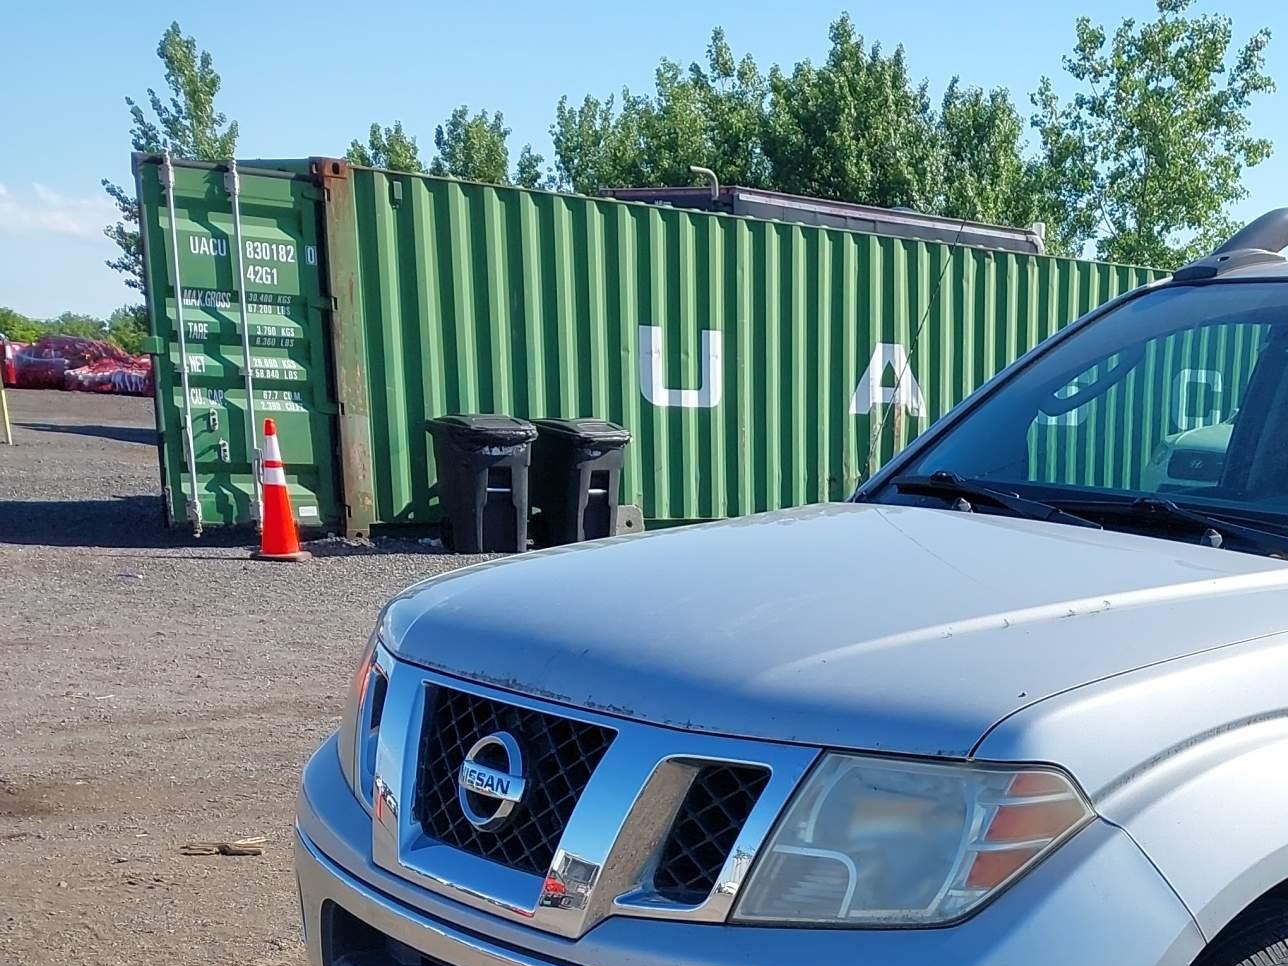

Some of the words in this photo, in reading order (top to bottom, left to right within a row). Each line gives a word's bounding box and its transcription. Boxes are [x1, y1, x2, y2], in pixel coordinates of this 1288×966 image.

[189, 235, 227, 256] UACU
[246, 240, 295, 262] 830182
[247, 265, 278, 285] 42G1
[277, 295, 291, 304] KGS
[277, 305, 291, 316] LBS
[188, 322, 208, 339] TARE
[281, 327, 295, 337] KGS
[280, 338, 295, 347] LBS
[189, 355, 206, 373] NET
[282, 358, 297, 369] KGS
[284, 370, 298, 380] LBS
[462, 764, 511, 795] NISSAN
